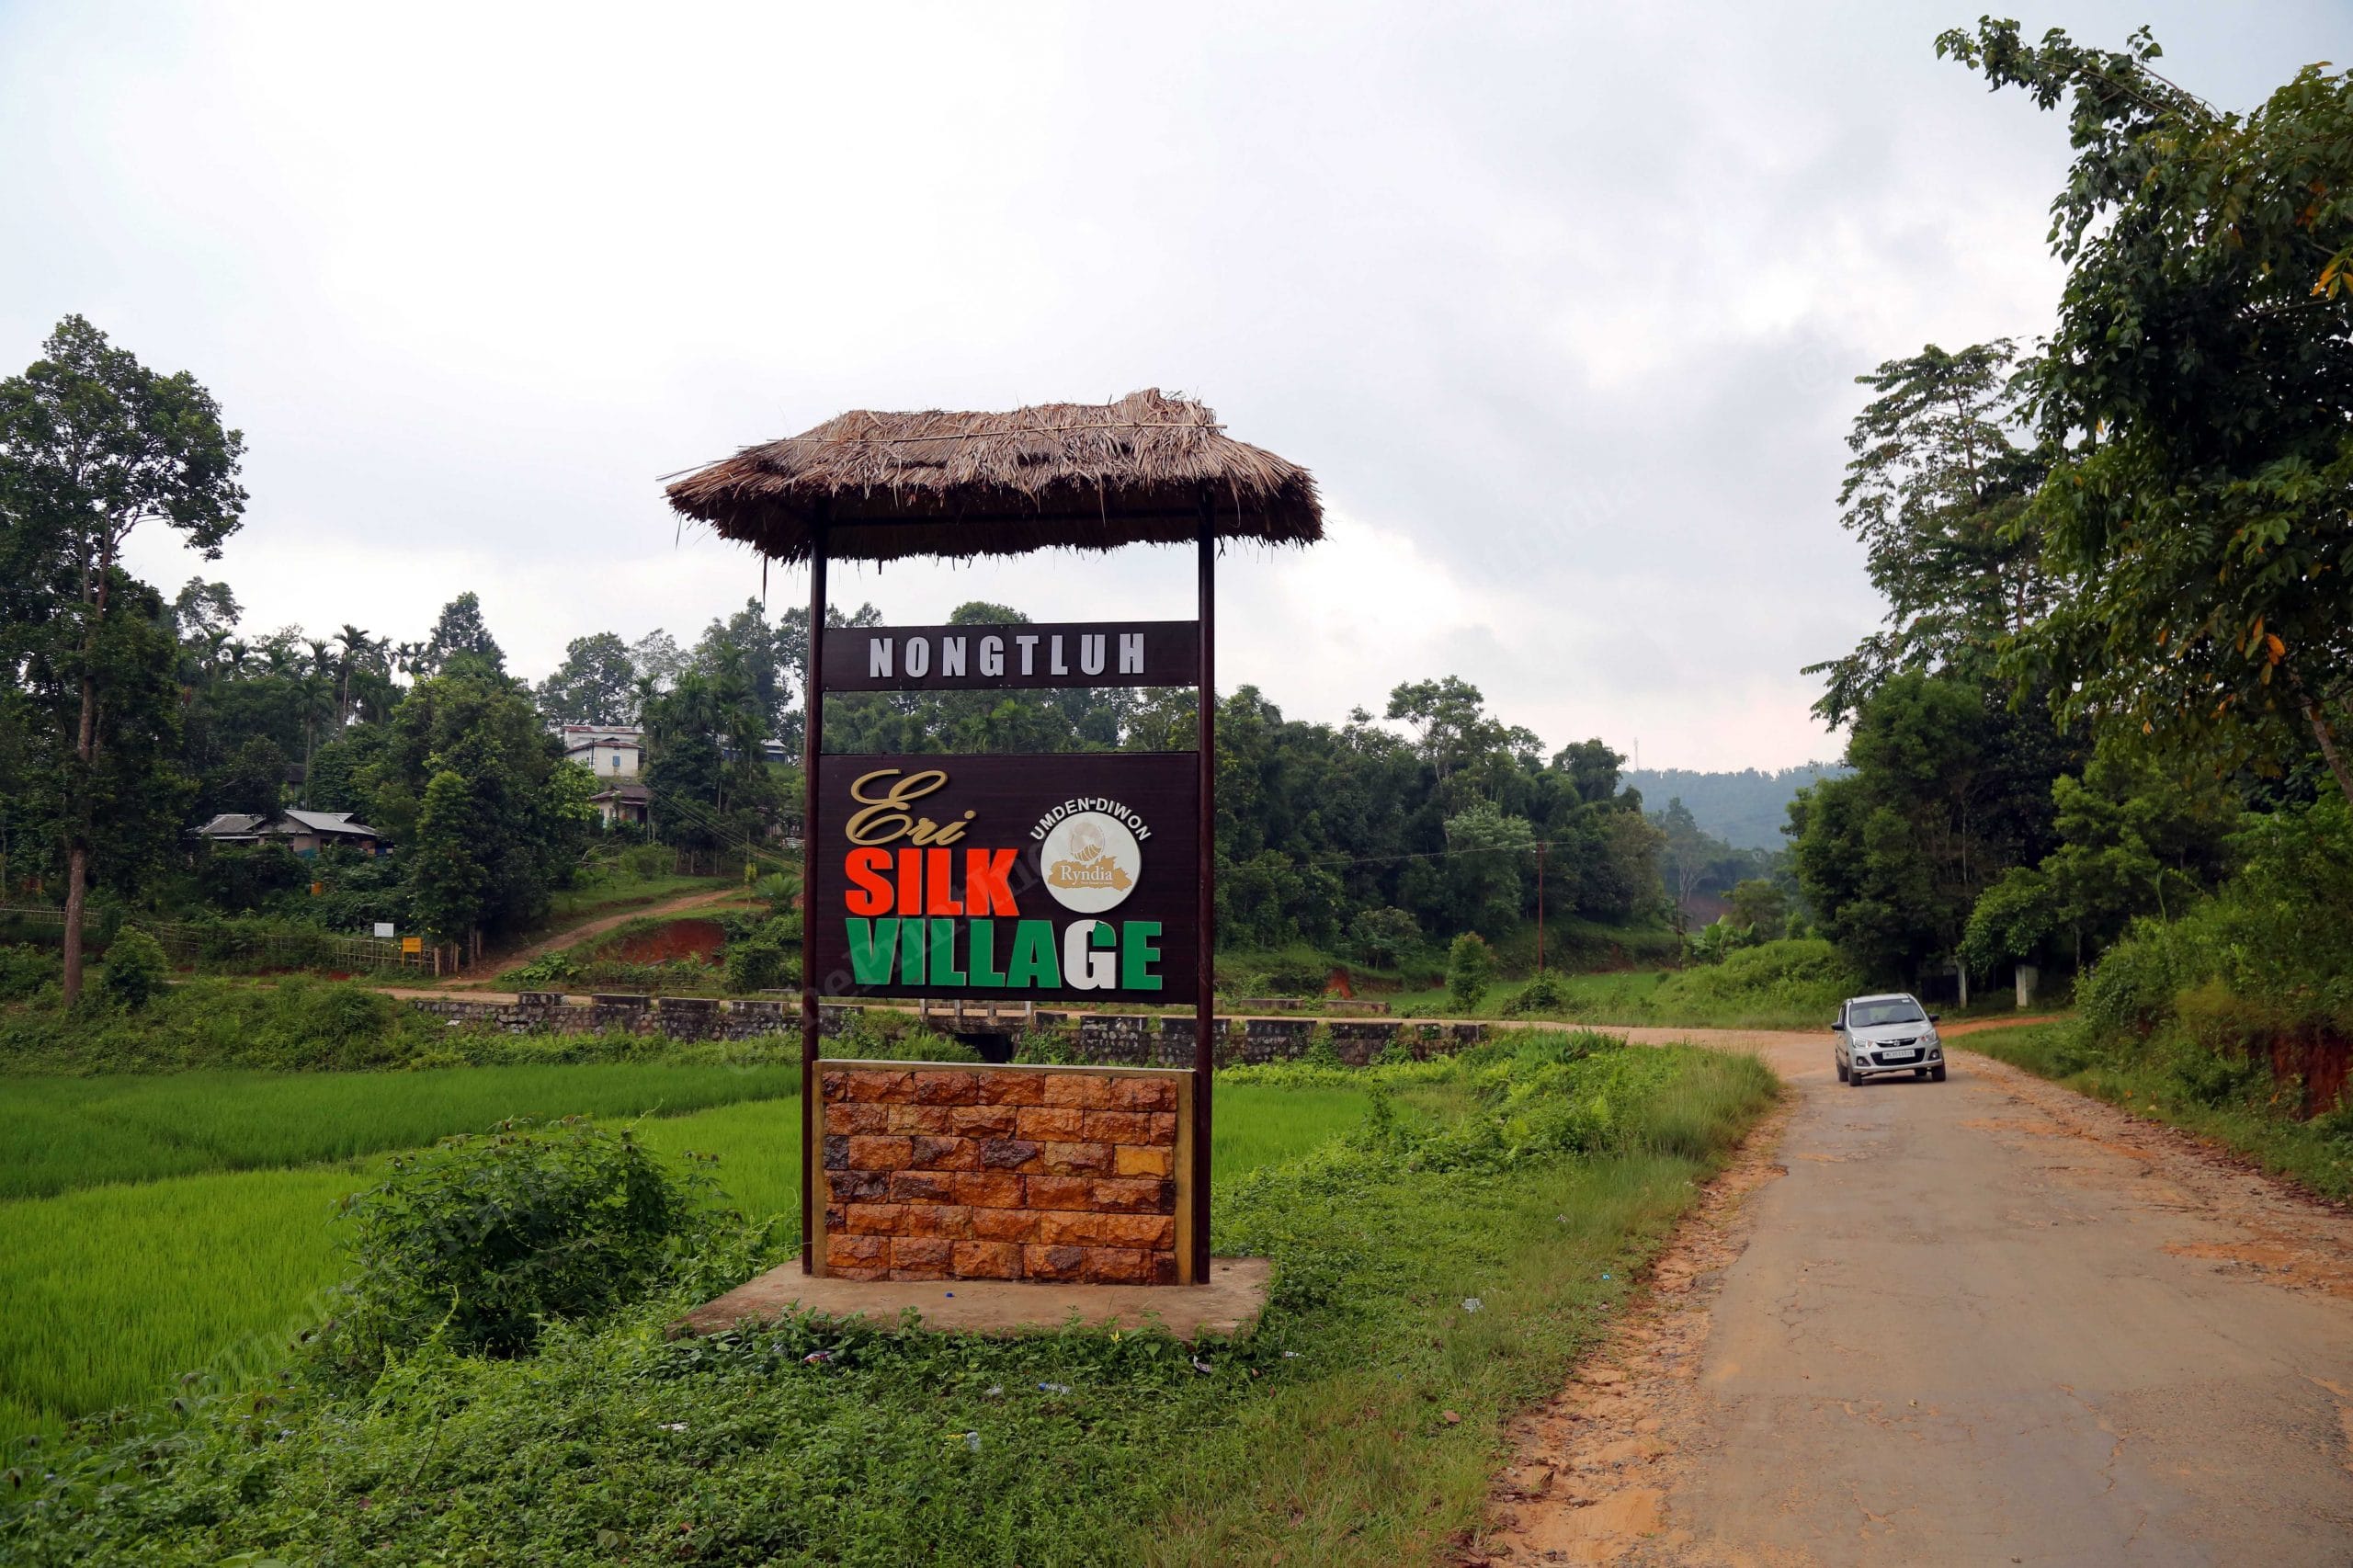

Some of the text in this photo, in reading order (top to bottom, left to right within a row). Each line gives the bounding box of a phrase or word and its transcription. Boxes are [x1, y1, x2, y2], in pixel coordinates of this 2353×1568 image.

[870, 632, 1145, 678] NONGTLUH
[846, 768, 977, 846] Eri
[1030, 797, 1152, 841] UMDEN-DIWON
[845, 846, 1019, 916] SILK
[1060, 865, 1113, 885] Ryndia
[845, 917, 1163, 991] VILLAGE
